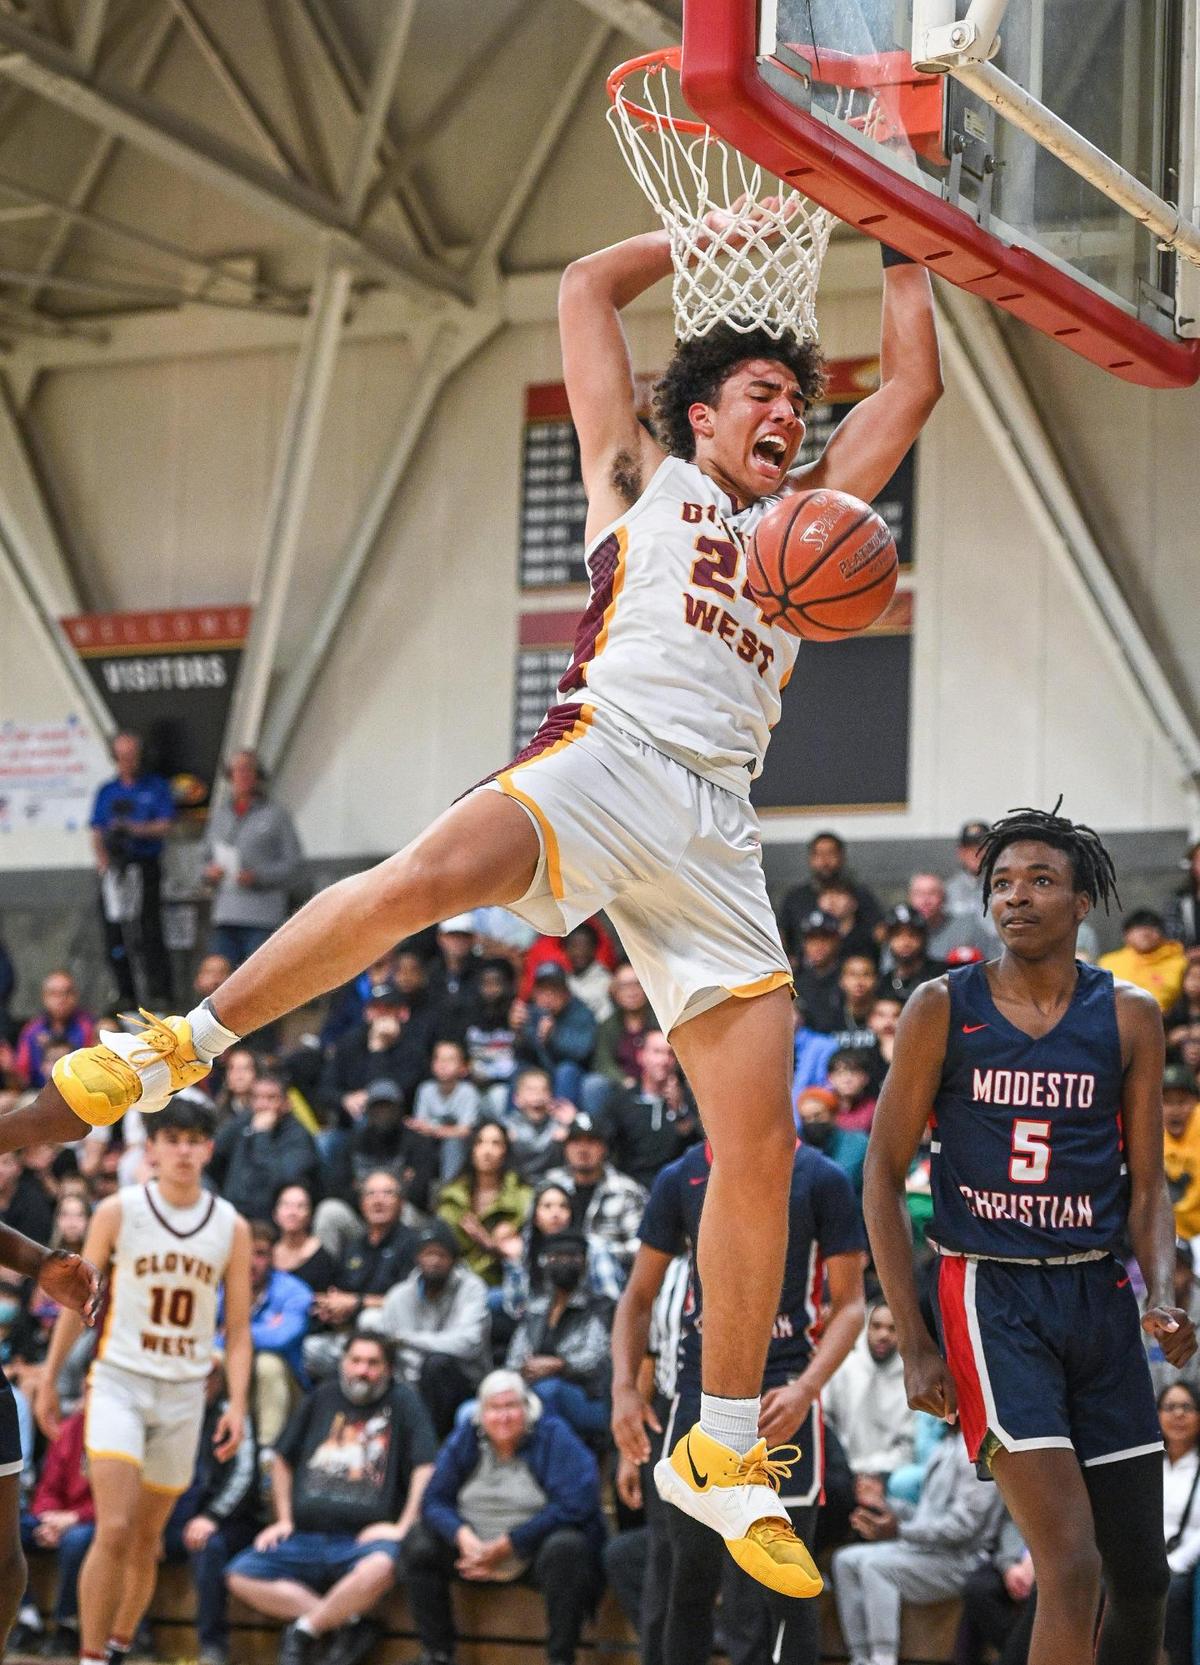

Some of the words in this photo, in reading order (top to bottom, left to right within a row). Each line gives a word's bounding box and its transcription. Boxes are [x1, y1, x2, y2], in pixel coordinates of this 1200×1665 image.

[683, 592, 775, 678] WEST
[102, 654, 227, 692] VISITORS
[971, 1067, 1096, 1109] MODESTO
[1008, 1117, 1052, 1184] 5
[150, 1286, 194, 1329] 10
[140, 1332, 195, 1361] WEST
